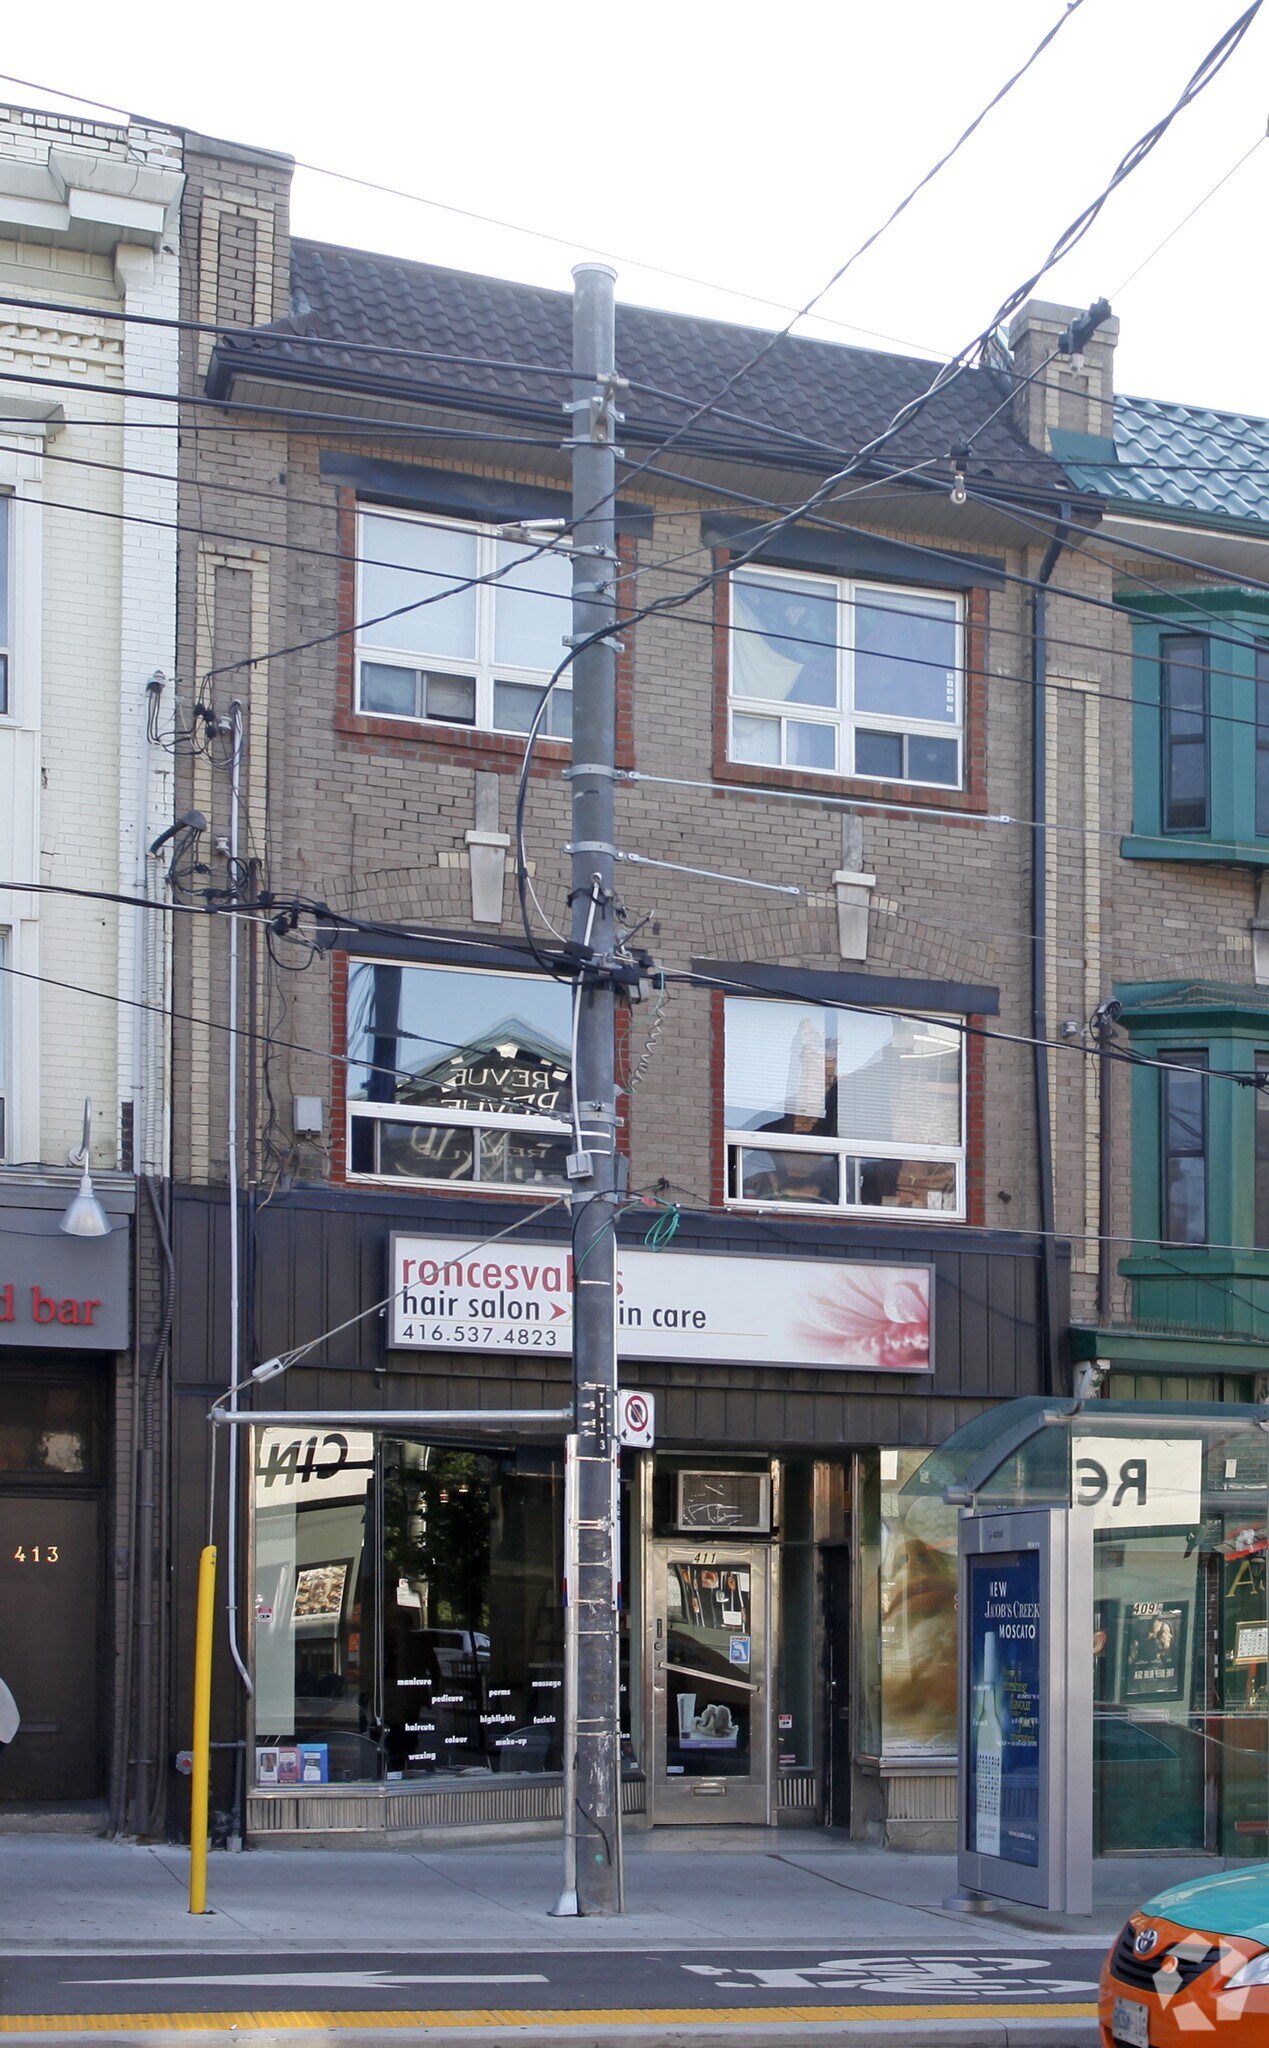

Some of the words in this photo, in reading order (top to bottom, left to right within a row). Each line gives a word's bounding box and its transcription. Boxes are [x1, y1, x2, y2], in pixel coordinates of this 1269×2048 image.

[402, 1254, 624, 1296] roncesval
[31, 1285, 102, 1325] bar
[402, 1285, 459, 1317] hair
[468, 1290, 540, 1321] salon
[618, 1300, 642, 1326] in
[652, 1306, 707, 1329] care
[402, 1323, 557, 1347] 416.537.4823
[13, 1545, 59, 1563] 413
[693, 1552, 717, 1564] 411
[989, 1581, 1007, 1597] NEW
[999, 1624, 1036, 1639] MOSCATO
[397, 1677, 432, 1686] manicure
[532, 1681, 562, 1689] massage
[489, 1689, 511, 1698] perms
[431, 1694, 464, 1705] pedicure
[480, 1714, 516, 1725] highlights
[533, 1715, 556, 1724] facials
[405, 1723, 435, 1731] haircuts
[445, 1735, 468, 1744] colour
[495, 1738, 528, 1747] make-up
[408, 1751, 437, 1760] waxing
